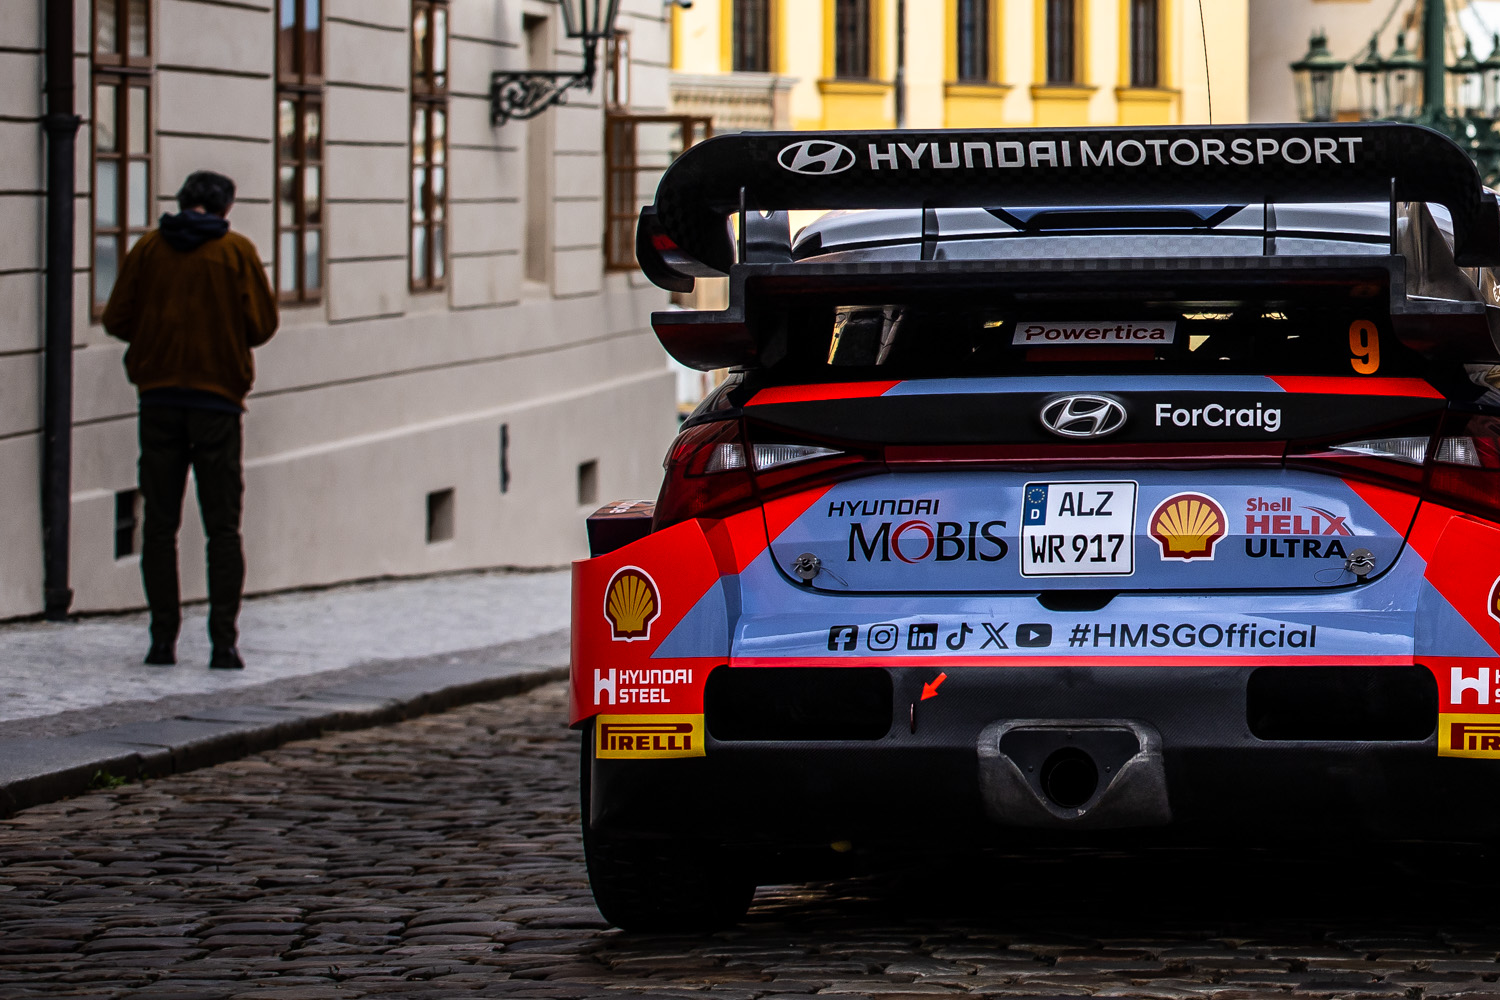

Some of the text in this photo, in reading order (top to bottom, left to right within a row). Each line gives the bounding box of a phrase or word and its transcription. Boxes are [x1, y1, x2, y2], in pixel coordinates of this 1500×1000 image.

[868, 137, 1363, 170] HYUNDAI MOTORSPORT
[1024, 323, 1165, 341] Powertica
[1349, 319, 1380, 375] 9
[1155, 402, 1282, 432] ForCraig
[828, 499, 940, 518] HYUNDAI
[1031, 508, 1040, 520] D
[1058, 491, 1114, 517] ALZ
[1246, 497, 1292, 512] Shell
[1245, 506, 1351, 536] HELIX
[847, 519, 1009, 564] MOBIS
[1031, 534, 1125, 563] WR 917
[1245, 538, 1347, 558] ULTRA
[1068, 623, 1316, 648] #HMSGOfficial
[619, 669, 692, 684] HYUNDAI
[619, 688, 671, 703] STEEL
[601, 723, 693, 750] PIRELLI
